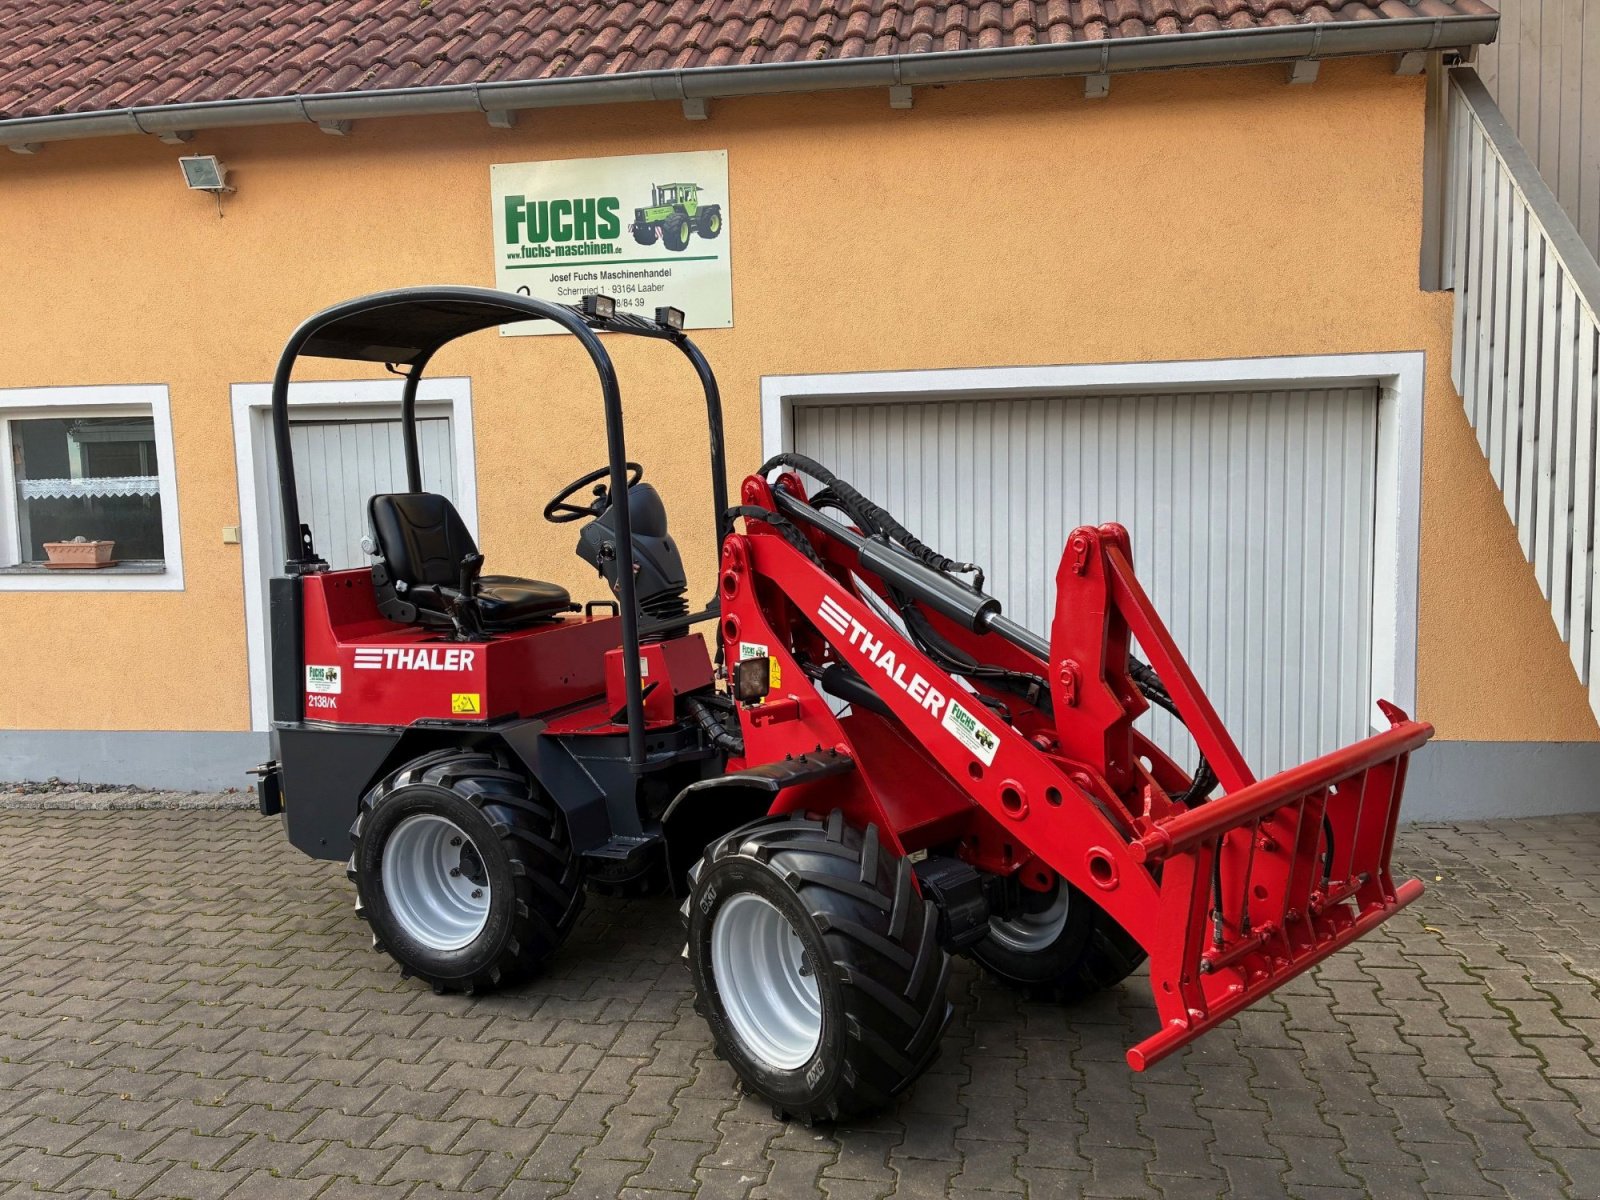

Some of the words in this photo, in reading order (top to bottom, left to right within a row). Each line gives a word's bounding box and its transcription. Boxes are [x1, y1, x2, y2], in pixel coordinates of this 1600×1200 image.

[505, 195, 620, 244] FUCHS
[507, 242, 622, 259] www.fuchs-maschinen.de
[549, 272, 572, 283] Josef
[573, 270, 598, 281] Fuchs
[600, 268, 672, 280] Maschinenhandel
[557, 285, 599, 296] Schernried
[601, 285, 605, 294] 1
[611, 284, 636, 294] 93164
[637, 282, 665, 293] Laaber
[616, 298, 633, 308] 8/84
[634, 297, 645, 307] 39
[383, 648, 475, 671] THALER
[849, 617, 946, 719] THALER
[308, 694, 337, 709] 2138/K
[951, 702, 977, 732] FUCHS
[700, 883, 717, 914] BKT
